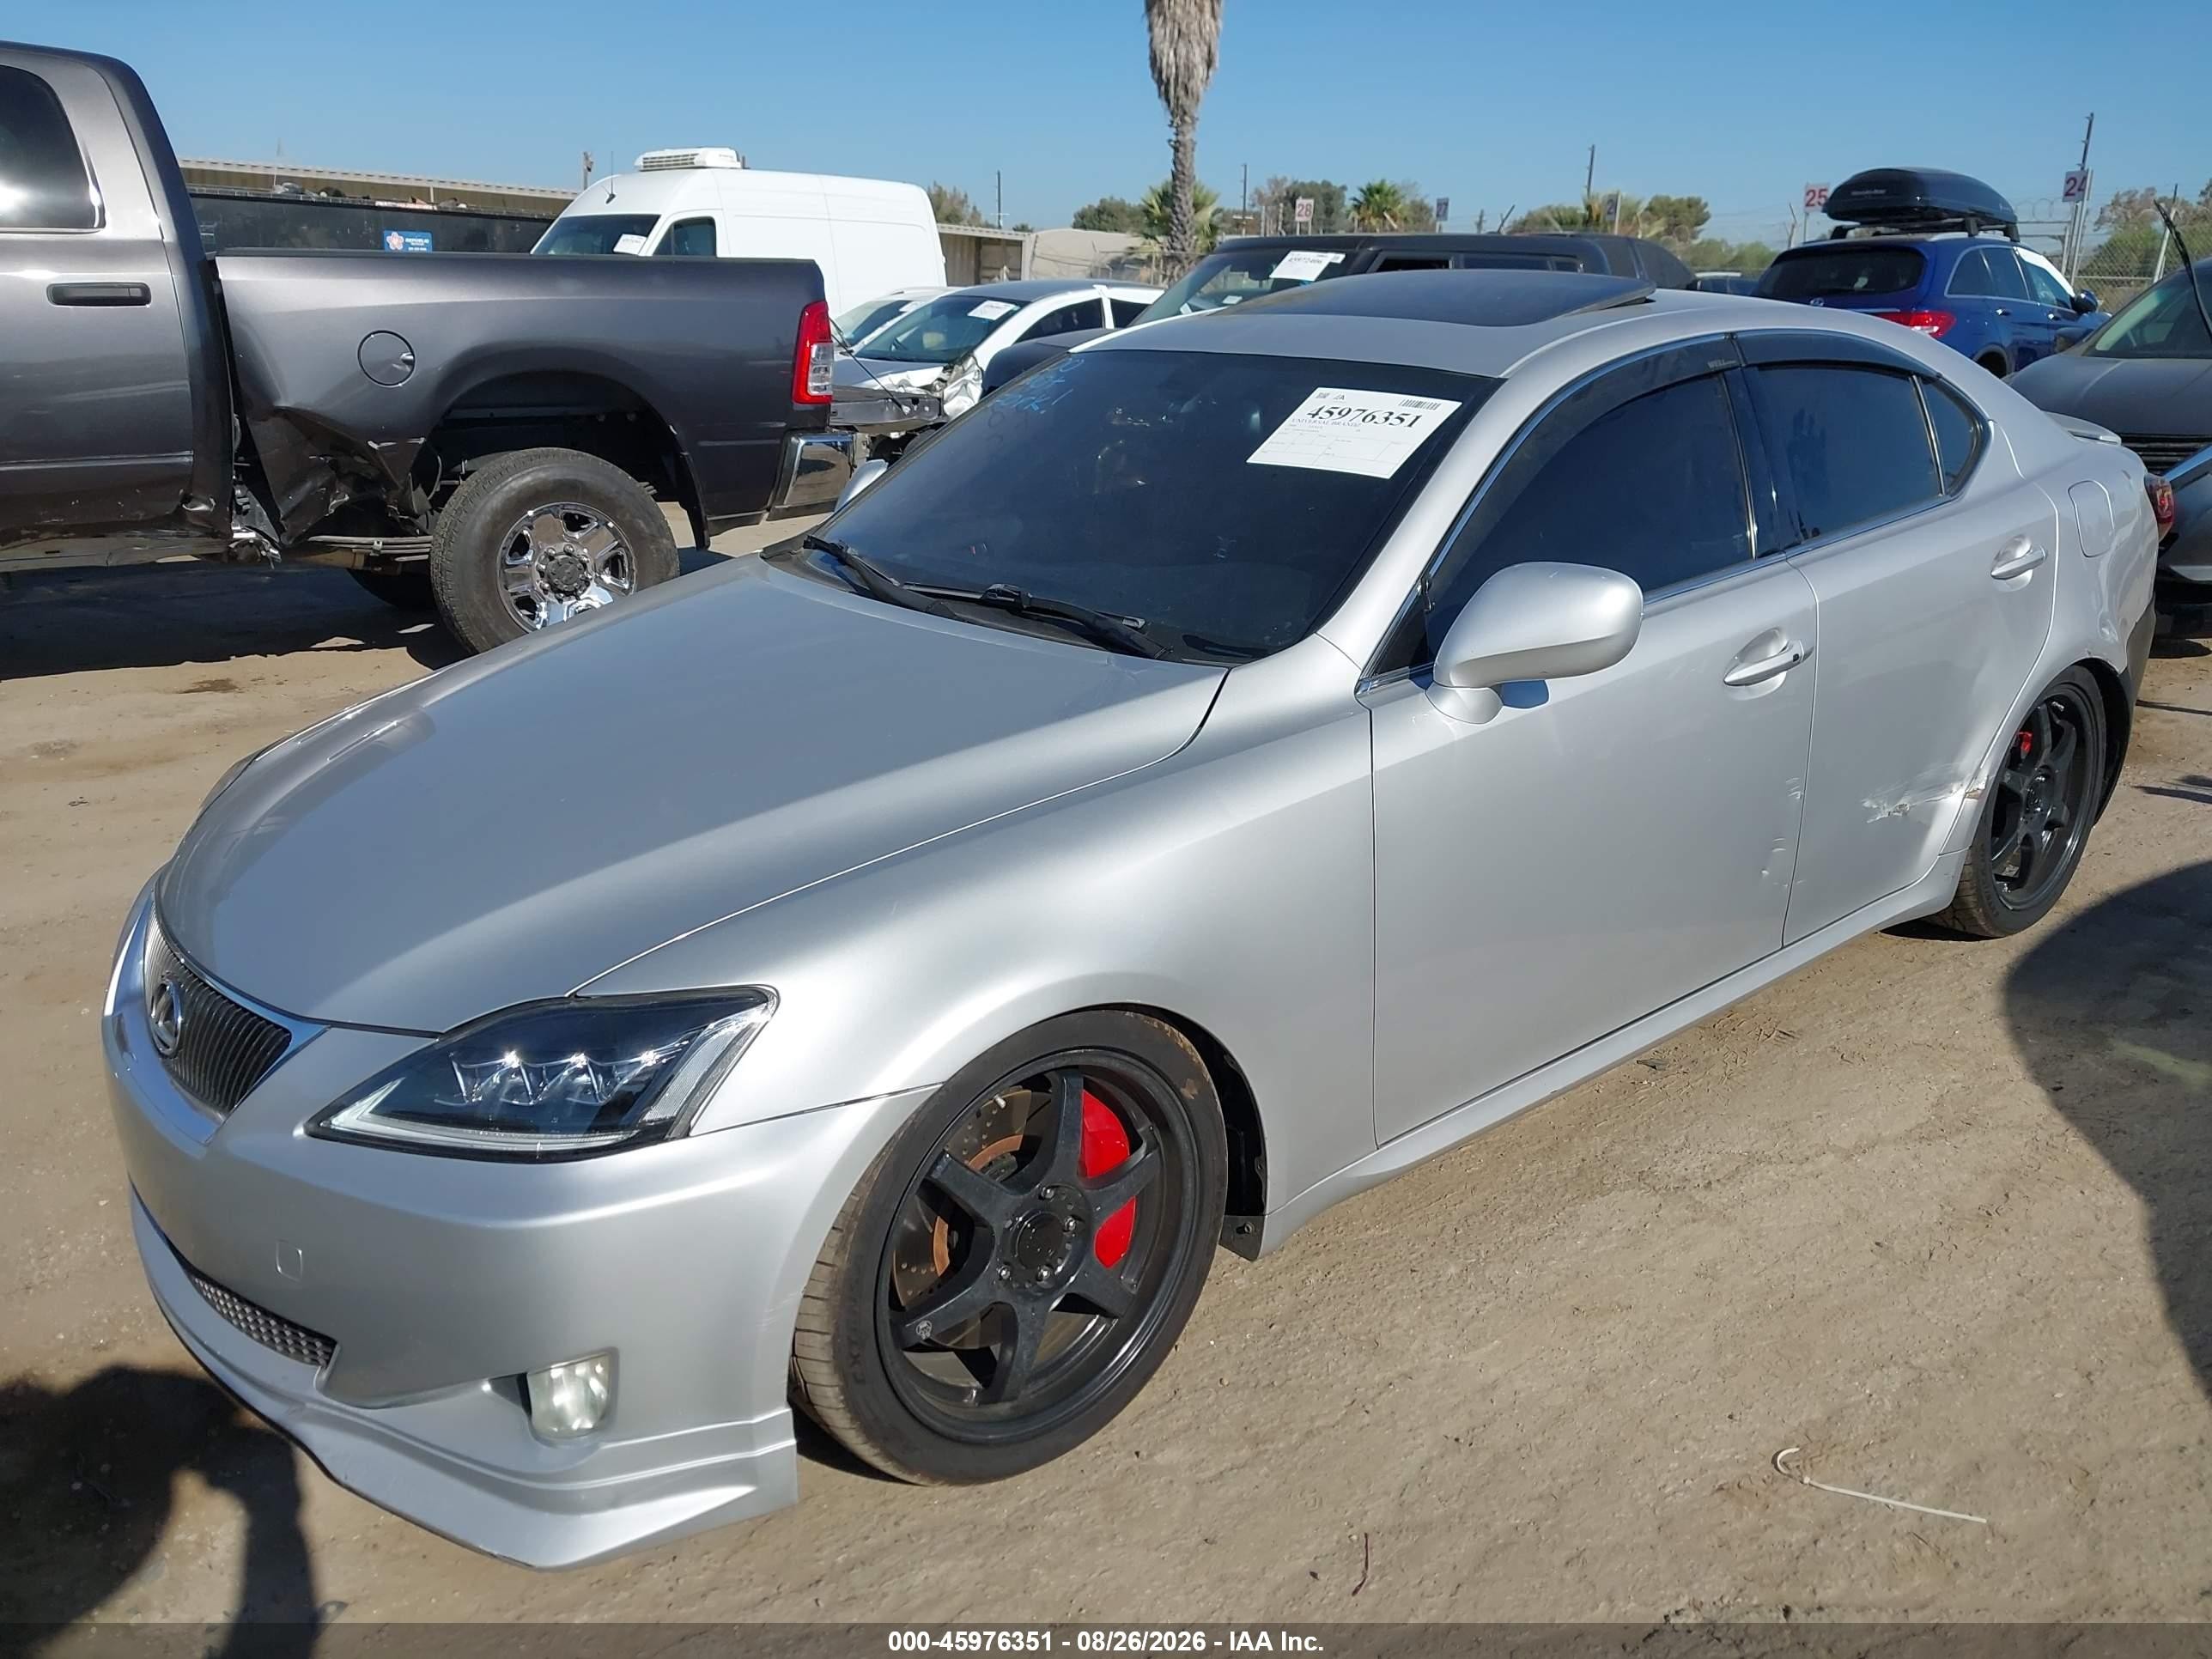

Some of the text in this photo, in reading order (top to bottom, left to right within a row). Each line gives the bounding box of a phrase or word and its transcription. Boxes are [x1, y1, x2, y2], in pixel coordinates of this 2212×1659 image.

[2064, 176, 2087, 197] 24
[1805, 188, 1828, 207] 25
[1297, 203, 1312, 216] 28
[1307, 405, 1423, 428] 45976351
